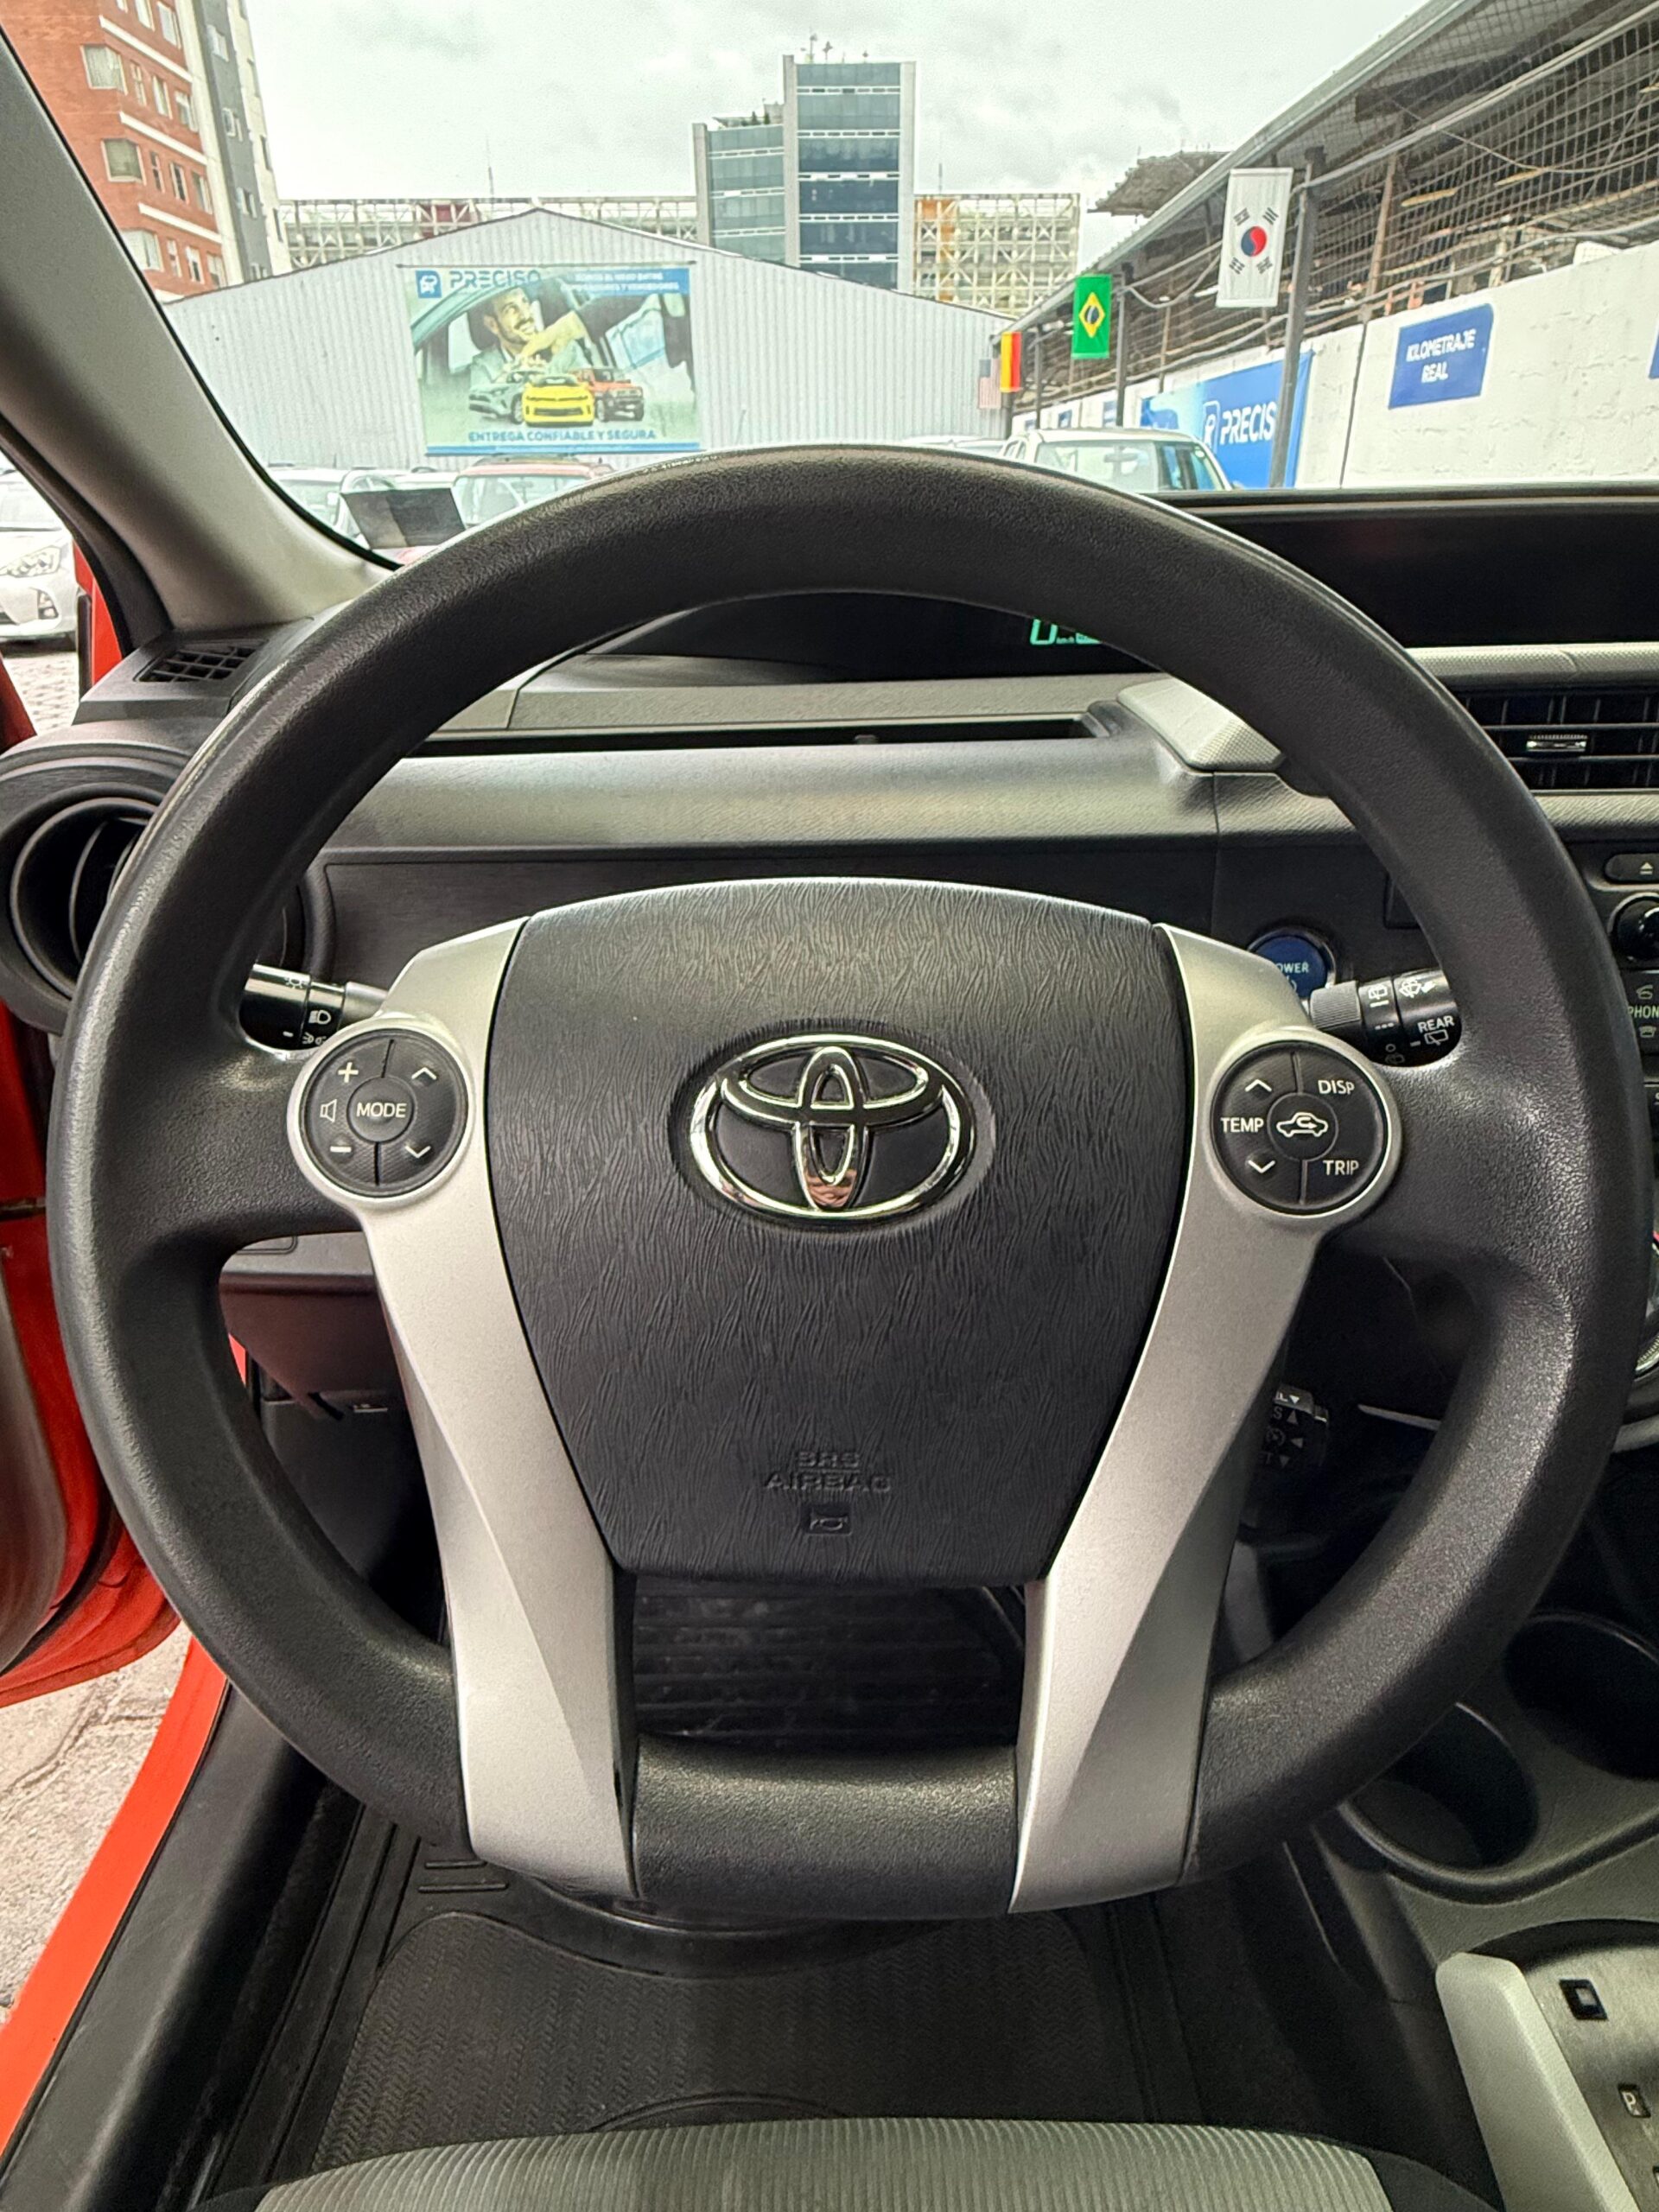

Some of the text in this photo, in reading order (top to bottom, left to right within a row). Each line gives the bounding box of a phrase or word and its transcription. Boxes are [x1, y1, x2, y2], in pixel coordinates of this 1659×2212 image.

[449, 270, 541, 288] PRECISO
[1406, 328, 1477, 362] KILOMETRAJE
[1421, 361, 1449, 384] REAL
[468, 429, 656, 442] ENTREGA CONFIABLE Y SEGURA
[1275, 961, 1309, 974] OWER
[1417, 1015, 1455, 1033] REAR
[1318, 1080, 1355, 1095] DISP
[356, 1102, 407, 1118] MODE
[1220, 1117, 1264, 1133] TEMP
[1323, 1160, 1359, 1176] TRIP
[765, 1471, 892, 1494] AIRBAG
